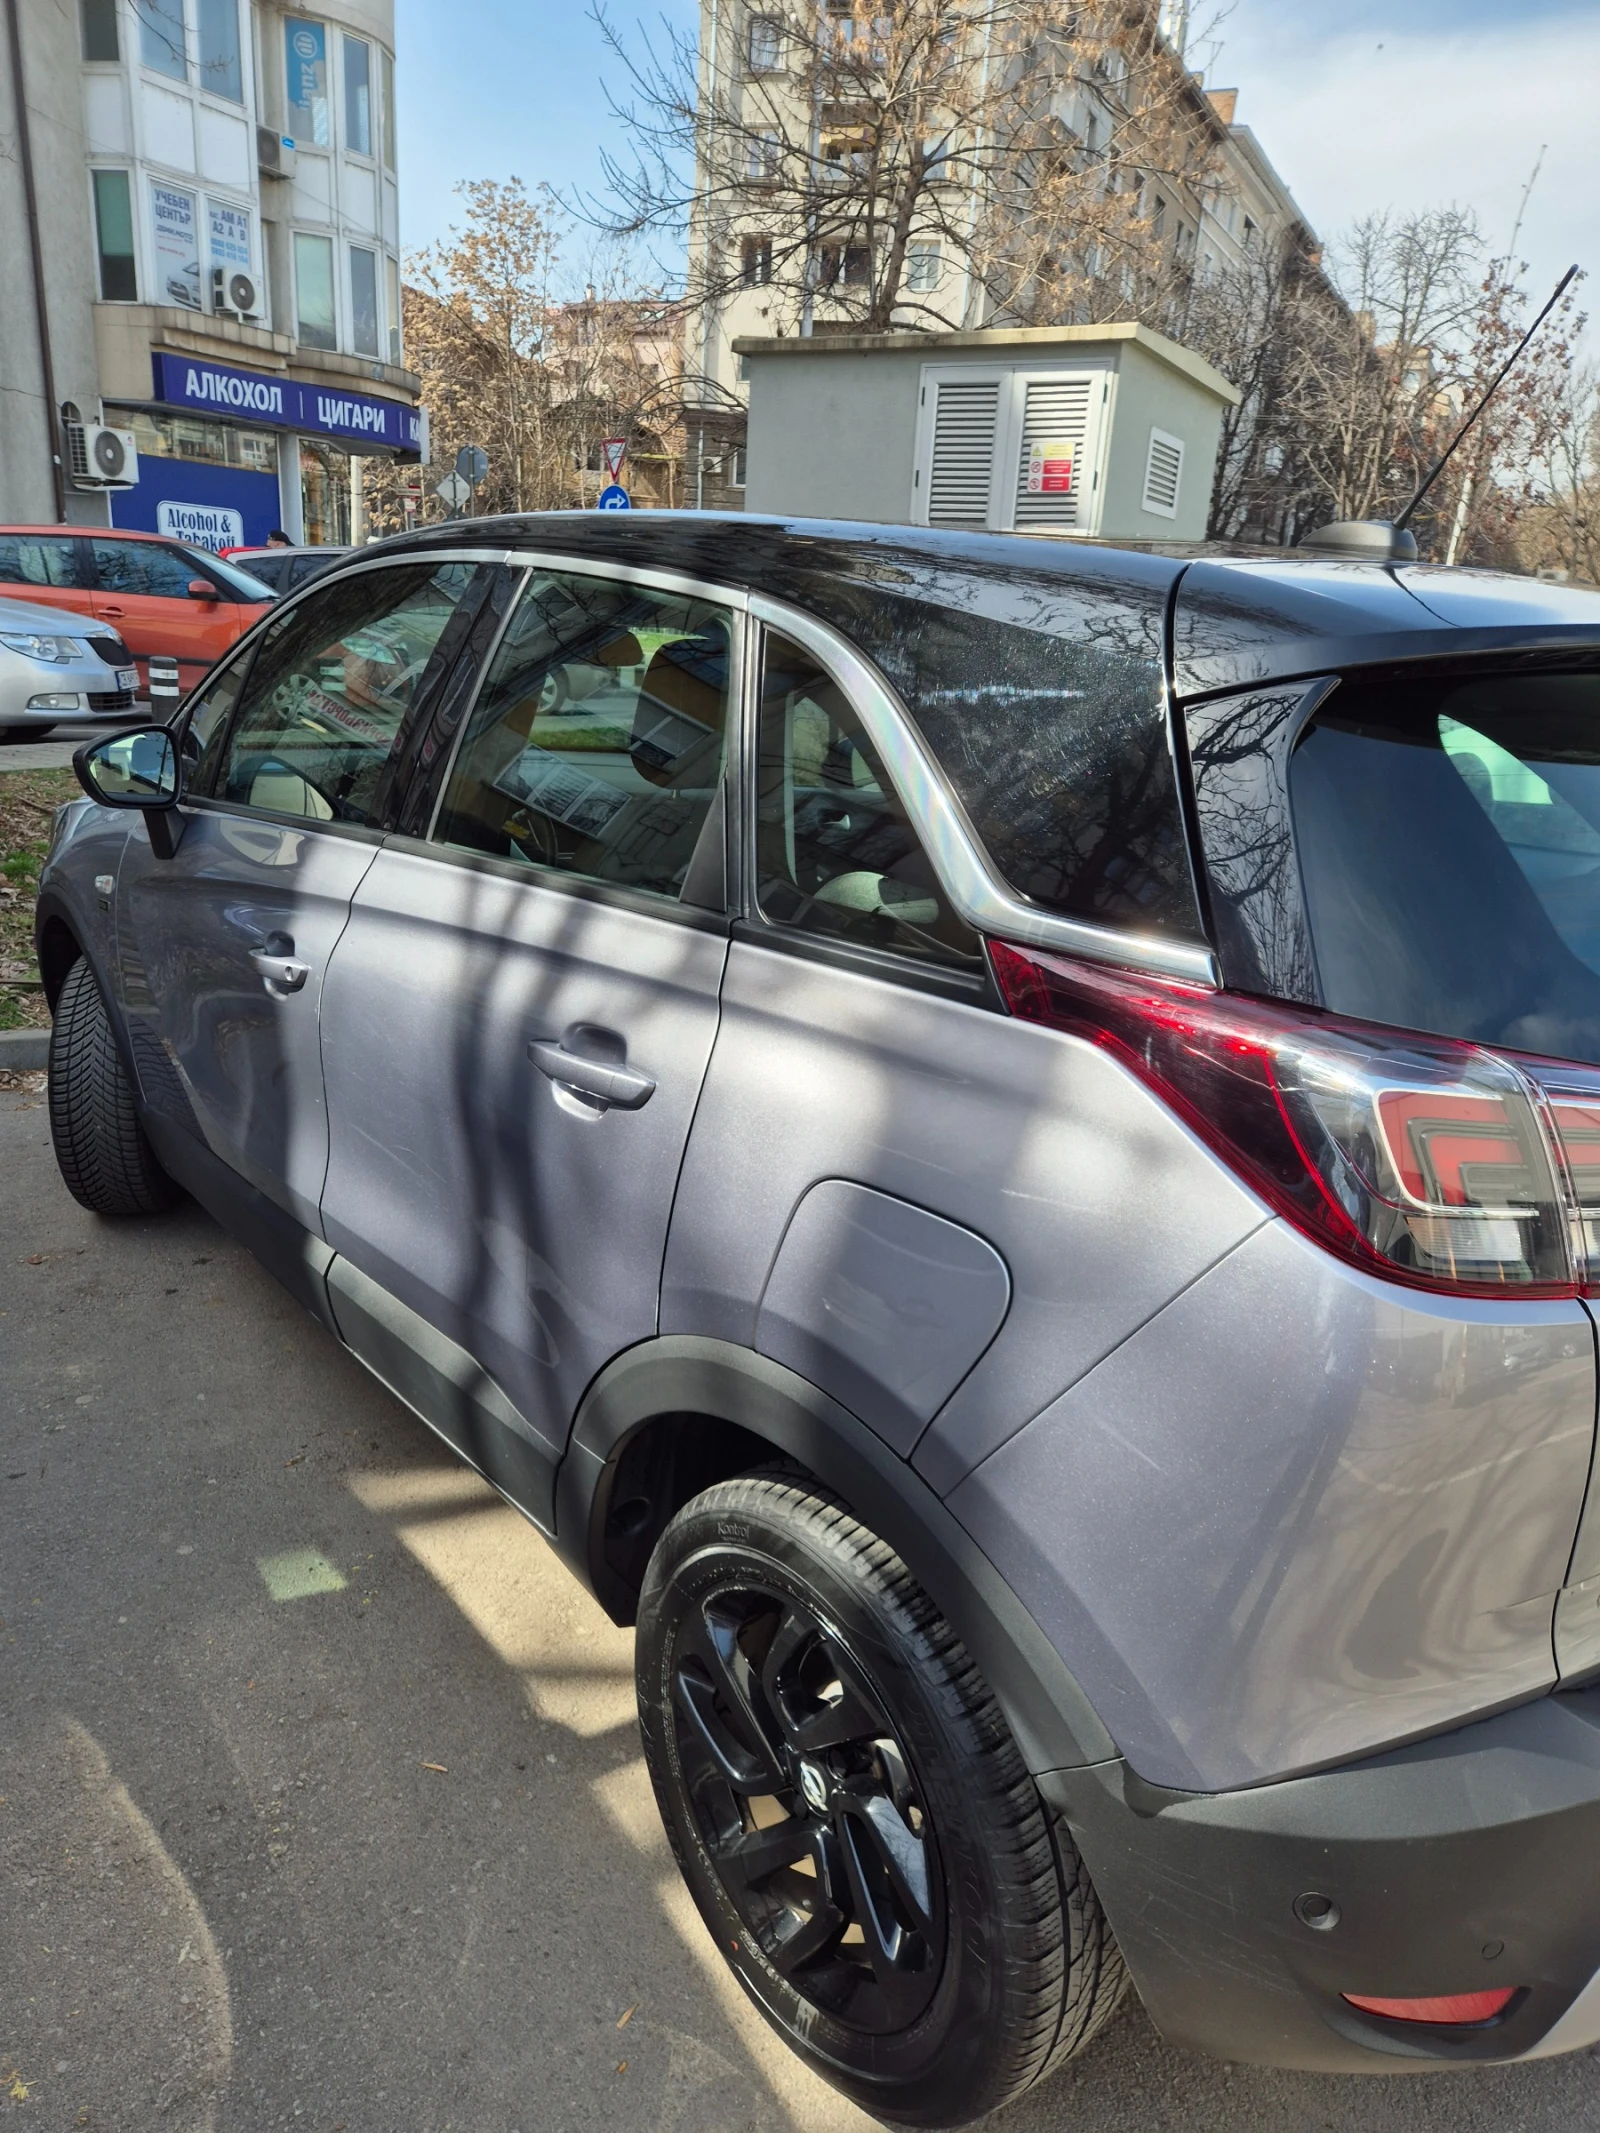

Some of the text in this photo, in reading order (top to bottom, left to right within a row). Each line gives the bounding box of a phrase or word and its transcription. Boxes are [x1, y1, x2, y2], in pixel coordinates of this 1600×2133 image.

[154, 188, 190, 211] УЧЕБЕН
[155, 203, 191, 225] ЦЕНТЪР
[185, 368, 283, 414] АЛКОХОЛ
[317, 396, 386, 434] ЦИГАРИ
[167, 508, 231, 533] Alcohol &
